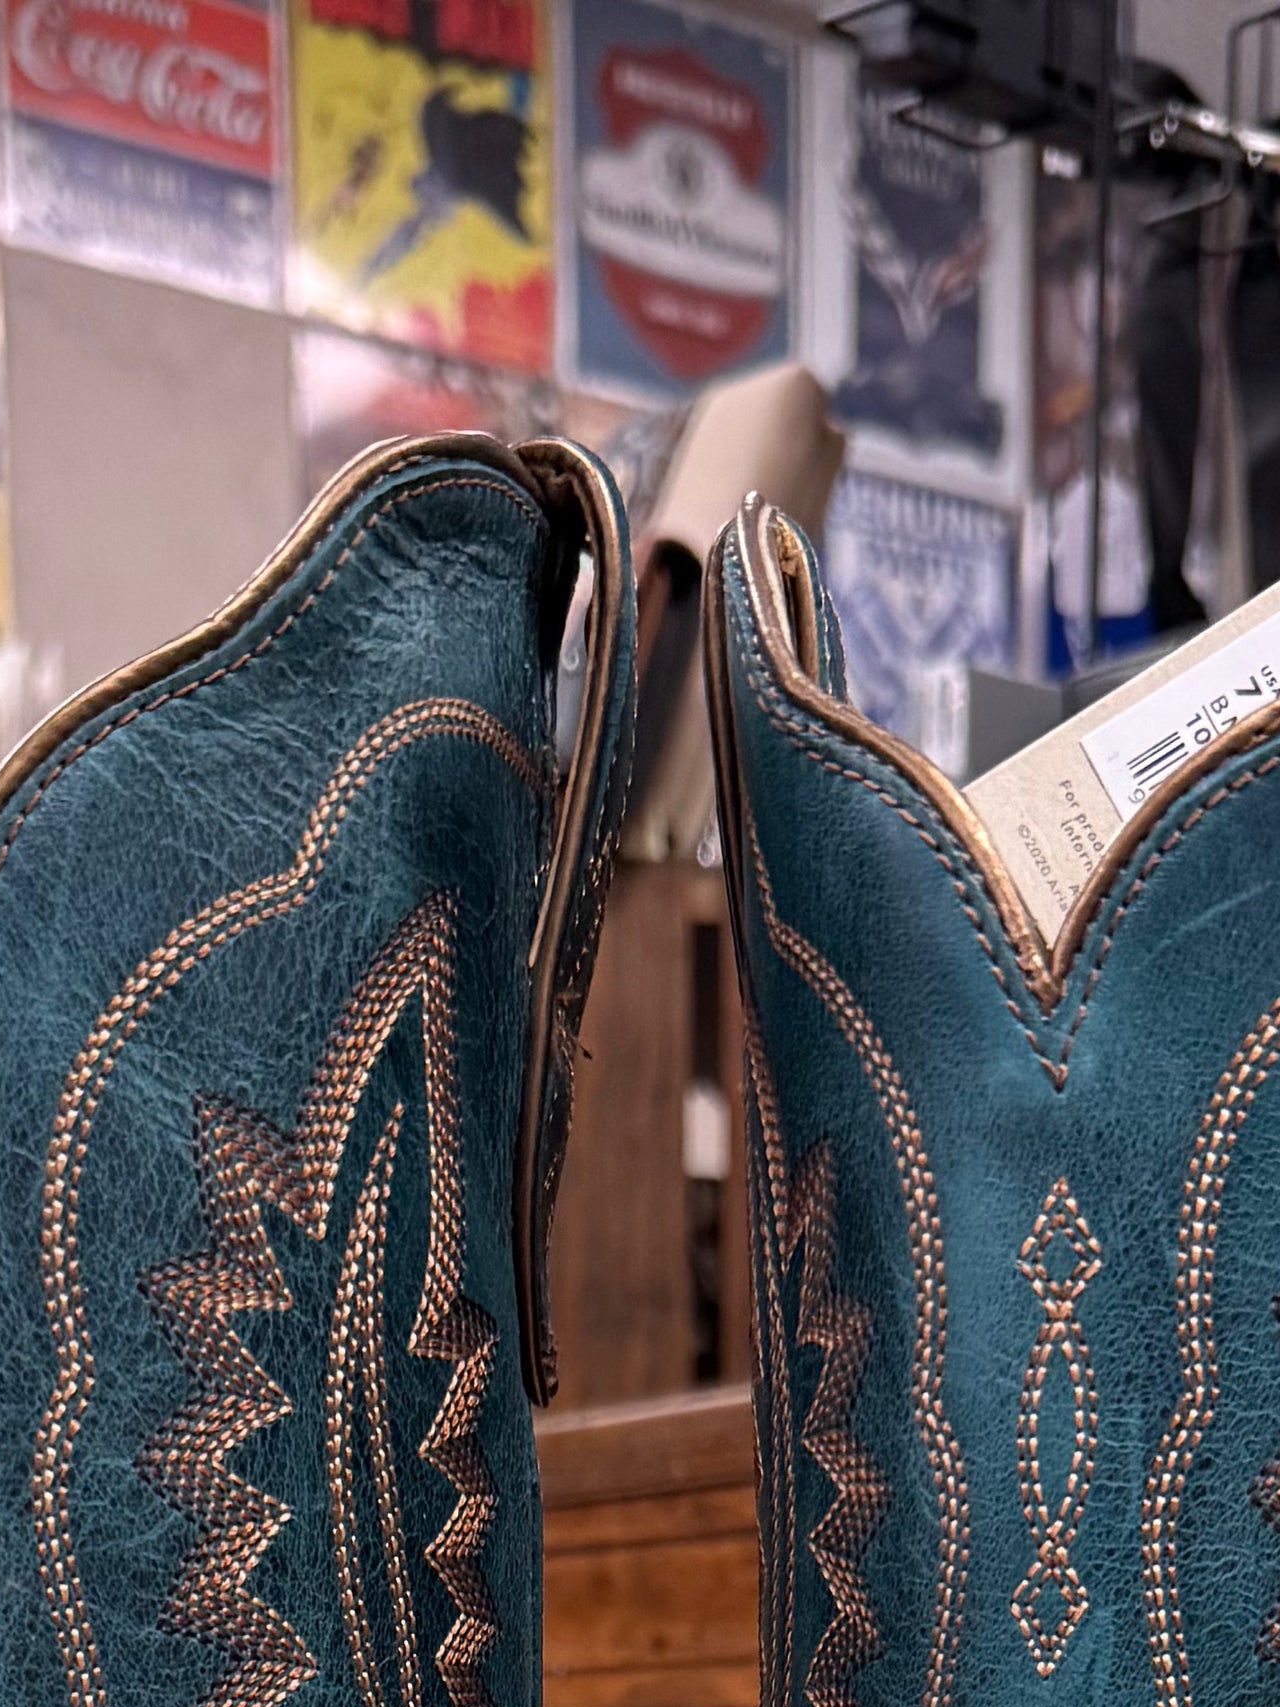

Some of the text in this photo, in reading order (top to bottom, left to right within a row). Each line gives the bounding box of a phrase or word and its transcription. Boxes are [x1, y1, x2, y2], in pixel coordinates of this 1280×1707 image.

[1233, 675, 1263, 697] 7
[1186, 712, 1212, 745] 10
[1059, 780, 1080, 809] For
